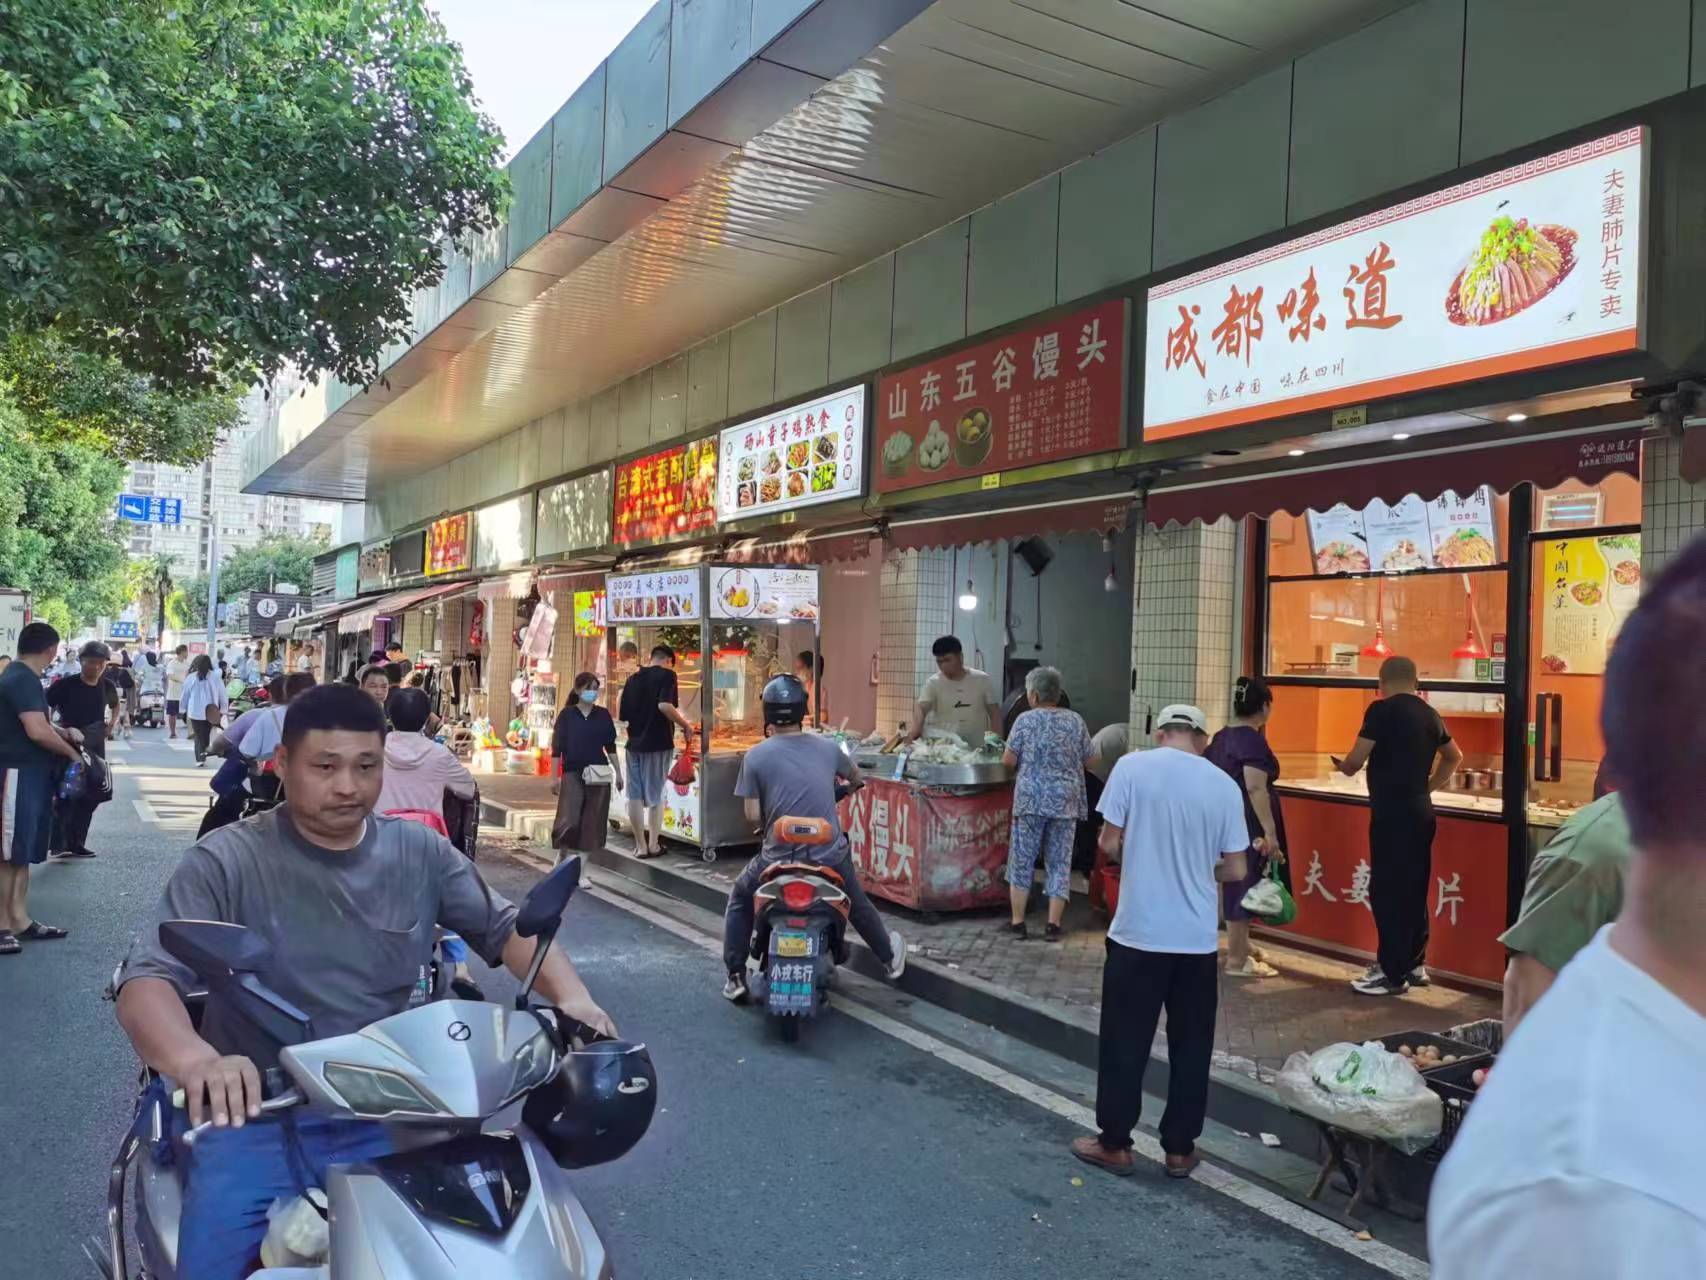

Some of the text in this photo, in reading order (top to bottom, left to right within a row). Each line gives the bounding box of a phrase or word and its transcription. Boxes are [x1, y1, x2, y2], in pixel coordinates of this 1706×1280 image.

[1600, 168, 1625, 318] 夫妻肺片专卖
[1166, 241, 1403, 378] 成都味道
[888, 318, 1107, 420] 山东五谷馒头
[1280, 358, 1344, 388] 味在四川
[838, 791, 915, 885] 谷馒头
[1301, 849, 1465, 926] 夫妻片
